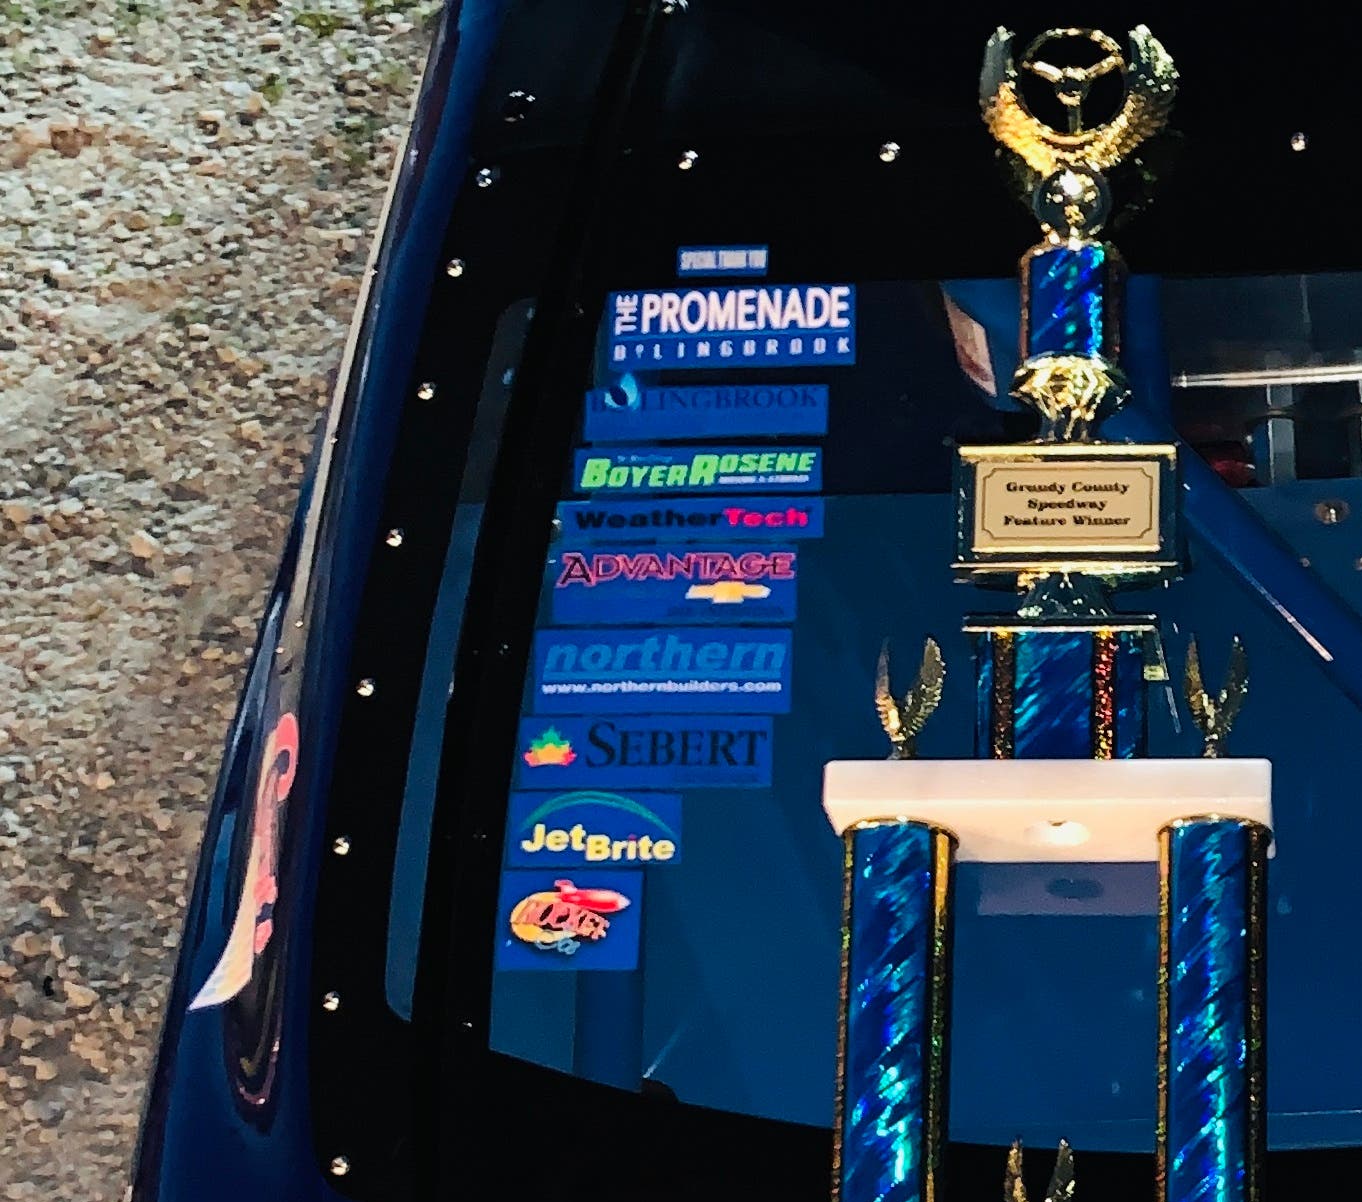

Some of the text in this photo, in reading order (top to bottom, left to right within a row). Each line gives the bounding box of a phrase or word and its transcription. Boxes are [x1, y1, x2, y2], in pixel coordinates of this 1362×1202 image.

[613, 286, 850, 336] THE PROMENADE
[1006, 481, 1130, 495] Grundy County
[1027, 499, 1107, 512] Speedway
[575, 507, 809, 530] WeatherTech
[1003, 515, 1131, 526] Feature Winner
[554, 552, 796, 587] ADVANTAGE
[543, 634, 787, 673] northern
[541, 680, 782, 695] www.northernbuilders.com
[586, 720, 768, 768] SEBERT
